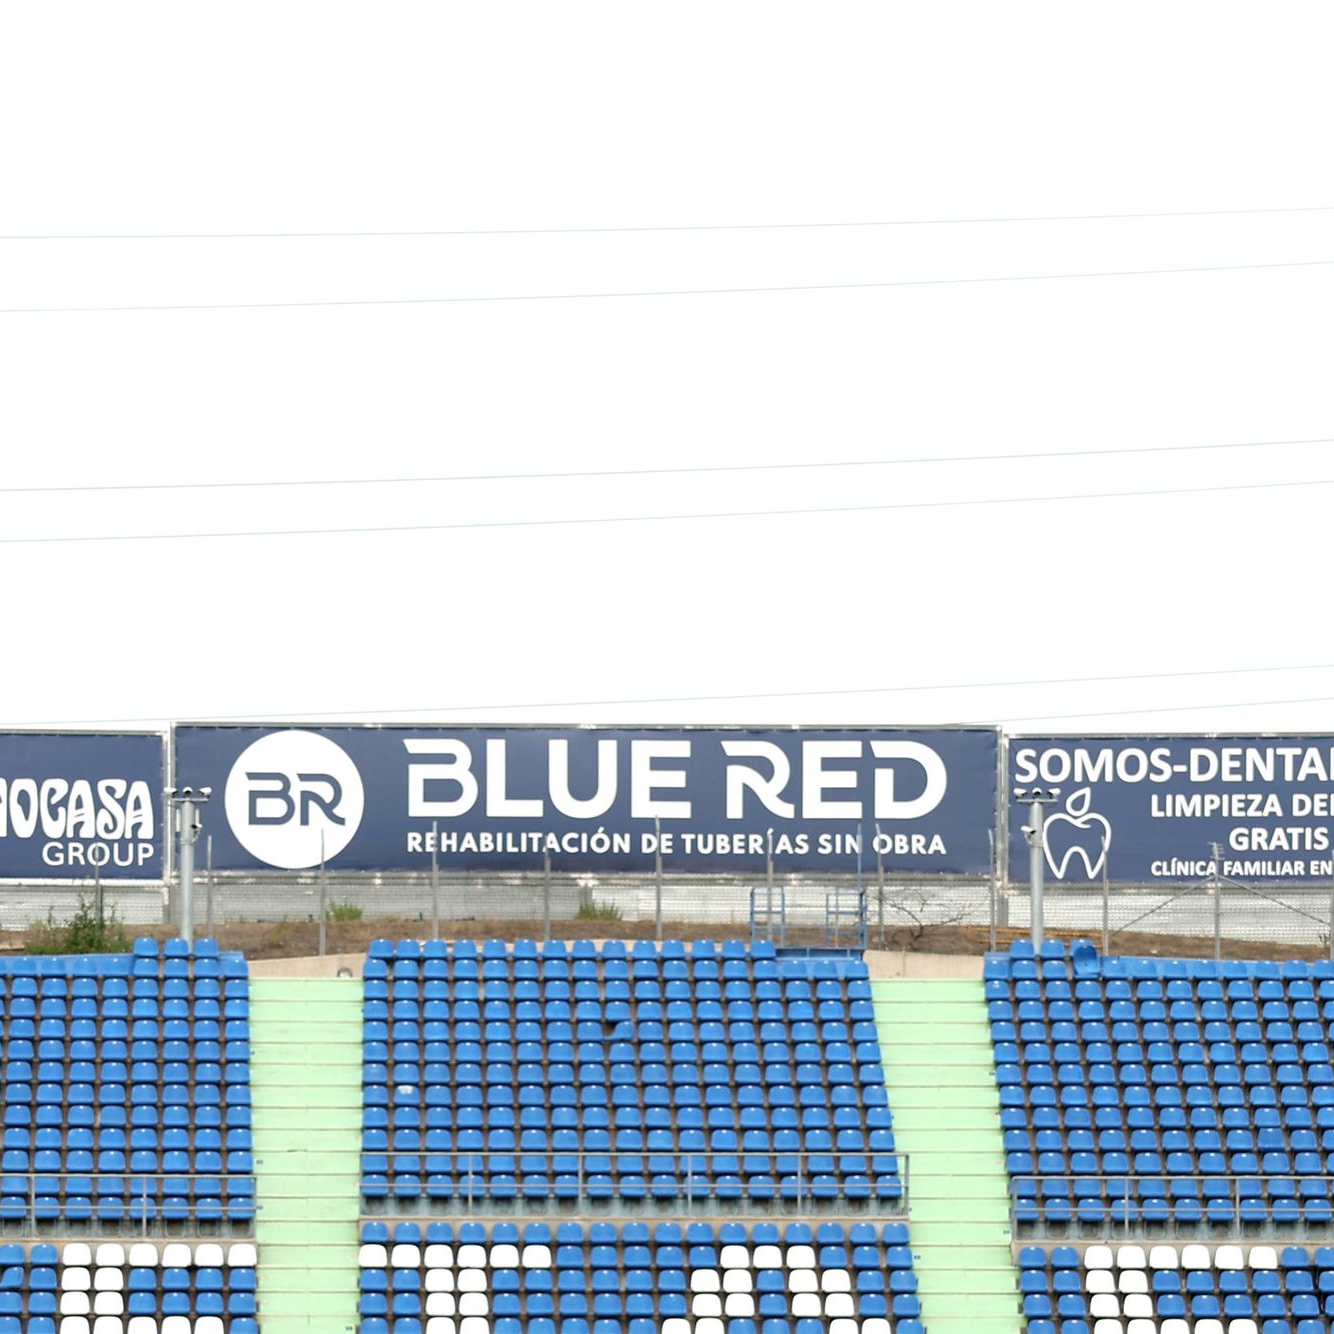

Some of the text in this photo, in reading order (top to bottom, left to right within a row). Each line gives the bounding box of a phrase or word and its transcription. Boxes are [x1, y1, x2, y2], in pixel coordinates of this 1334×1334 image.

[403, 739, 947, 819] BLUE RED
[245, 771, 346, 827] BR
[1151, 794, 1284, 818] LIMPIEZA
[408, 827, 947, 855] REHABILITACIÓN DE TUBERÍAS SIN OBRA
[1229, 826, 1329, 851] GRATIS
[43, 842, 155, 867] GROUP
[1151, 856, 1217, 877] CLÍNICA
[1223, 860, 1305, 876] FAMILIAR
[1310, 860, 1333, 876] EN
